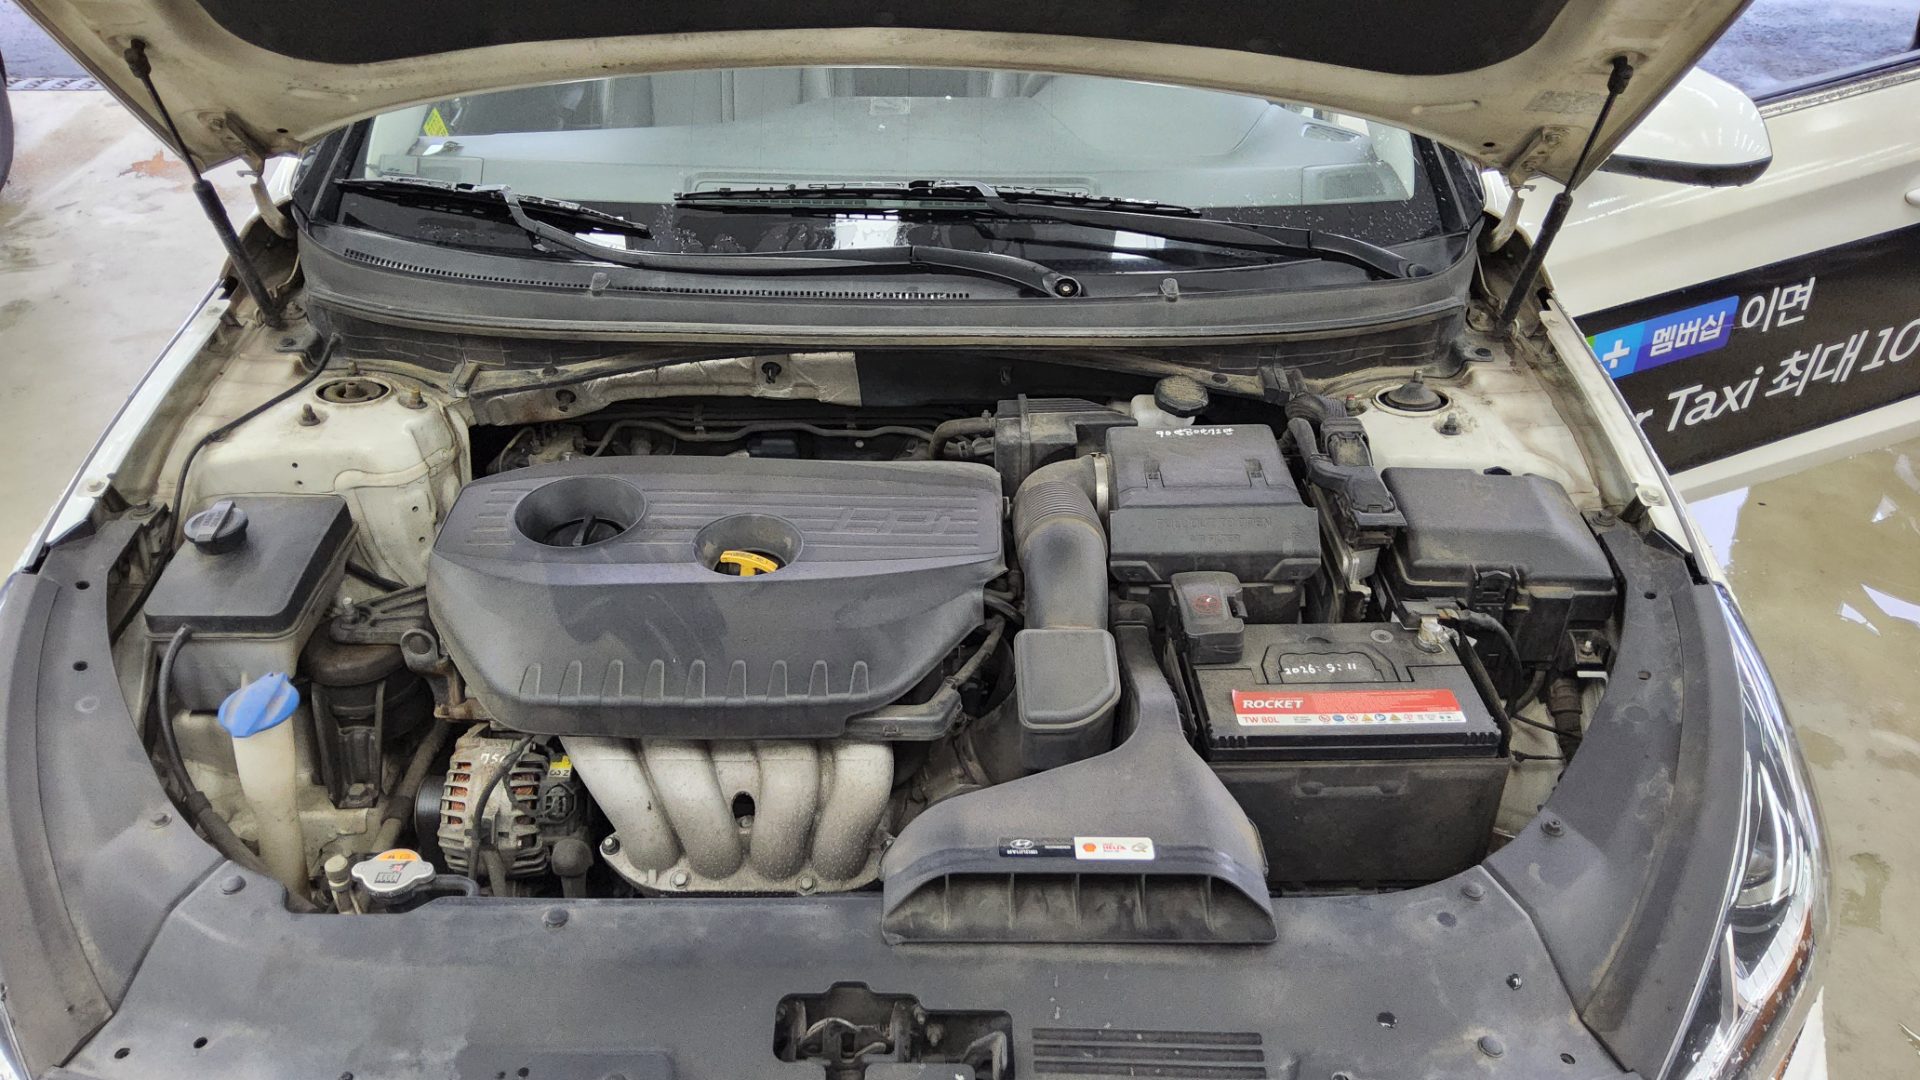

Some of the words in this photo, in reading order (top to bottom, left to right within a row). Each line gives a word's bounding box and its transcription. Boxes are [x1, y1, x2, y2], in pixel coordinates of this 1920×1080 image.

[1650, 311, 1727, 357] 멤버십
[1741, 276, 1816, 332] 이면
[1667, 366, 1764, 432] Taxi
[1765, 329, 1870, 397] 최대
[1242, 699, 1304, 709] ROCKET
[1242, 716, 1258, 724] TW
